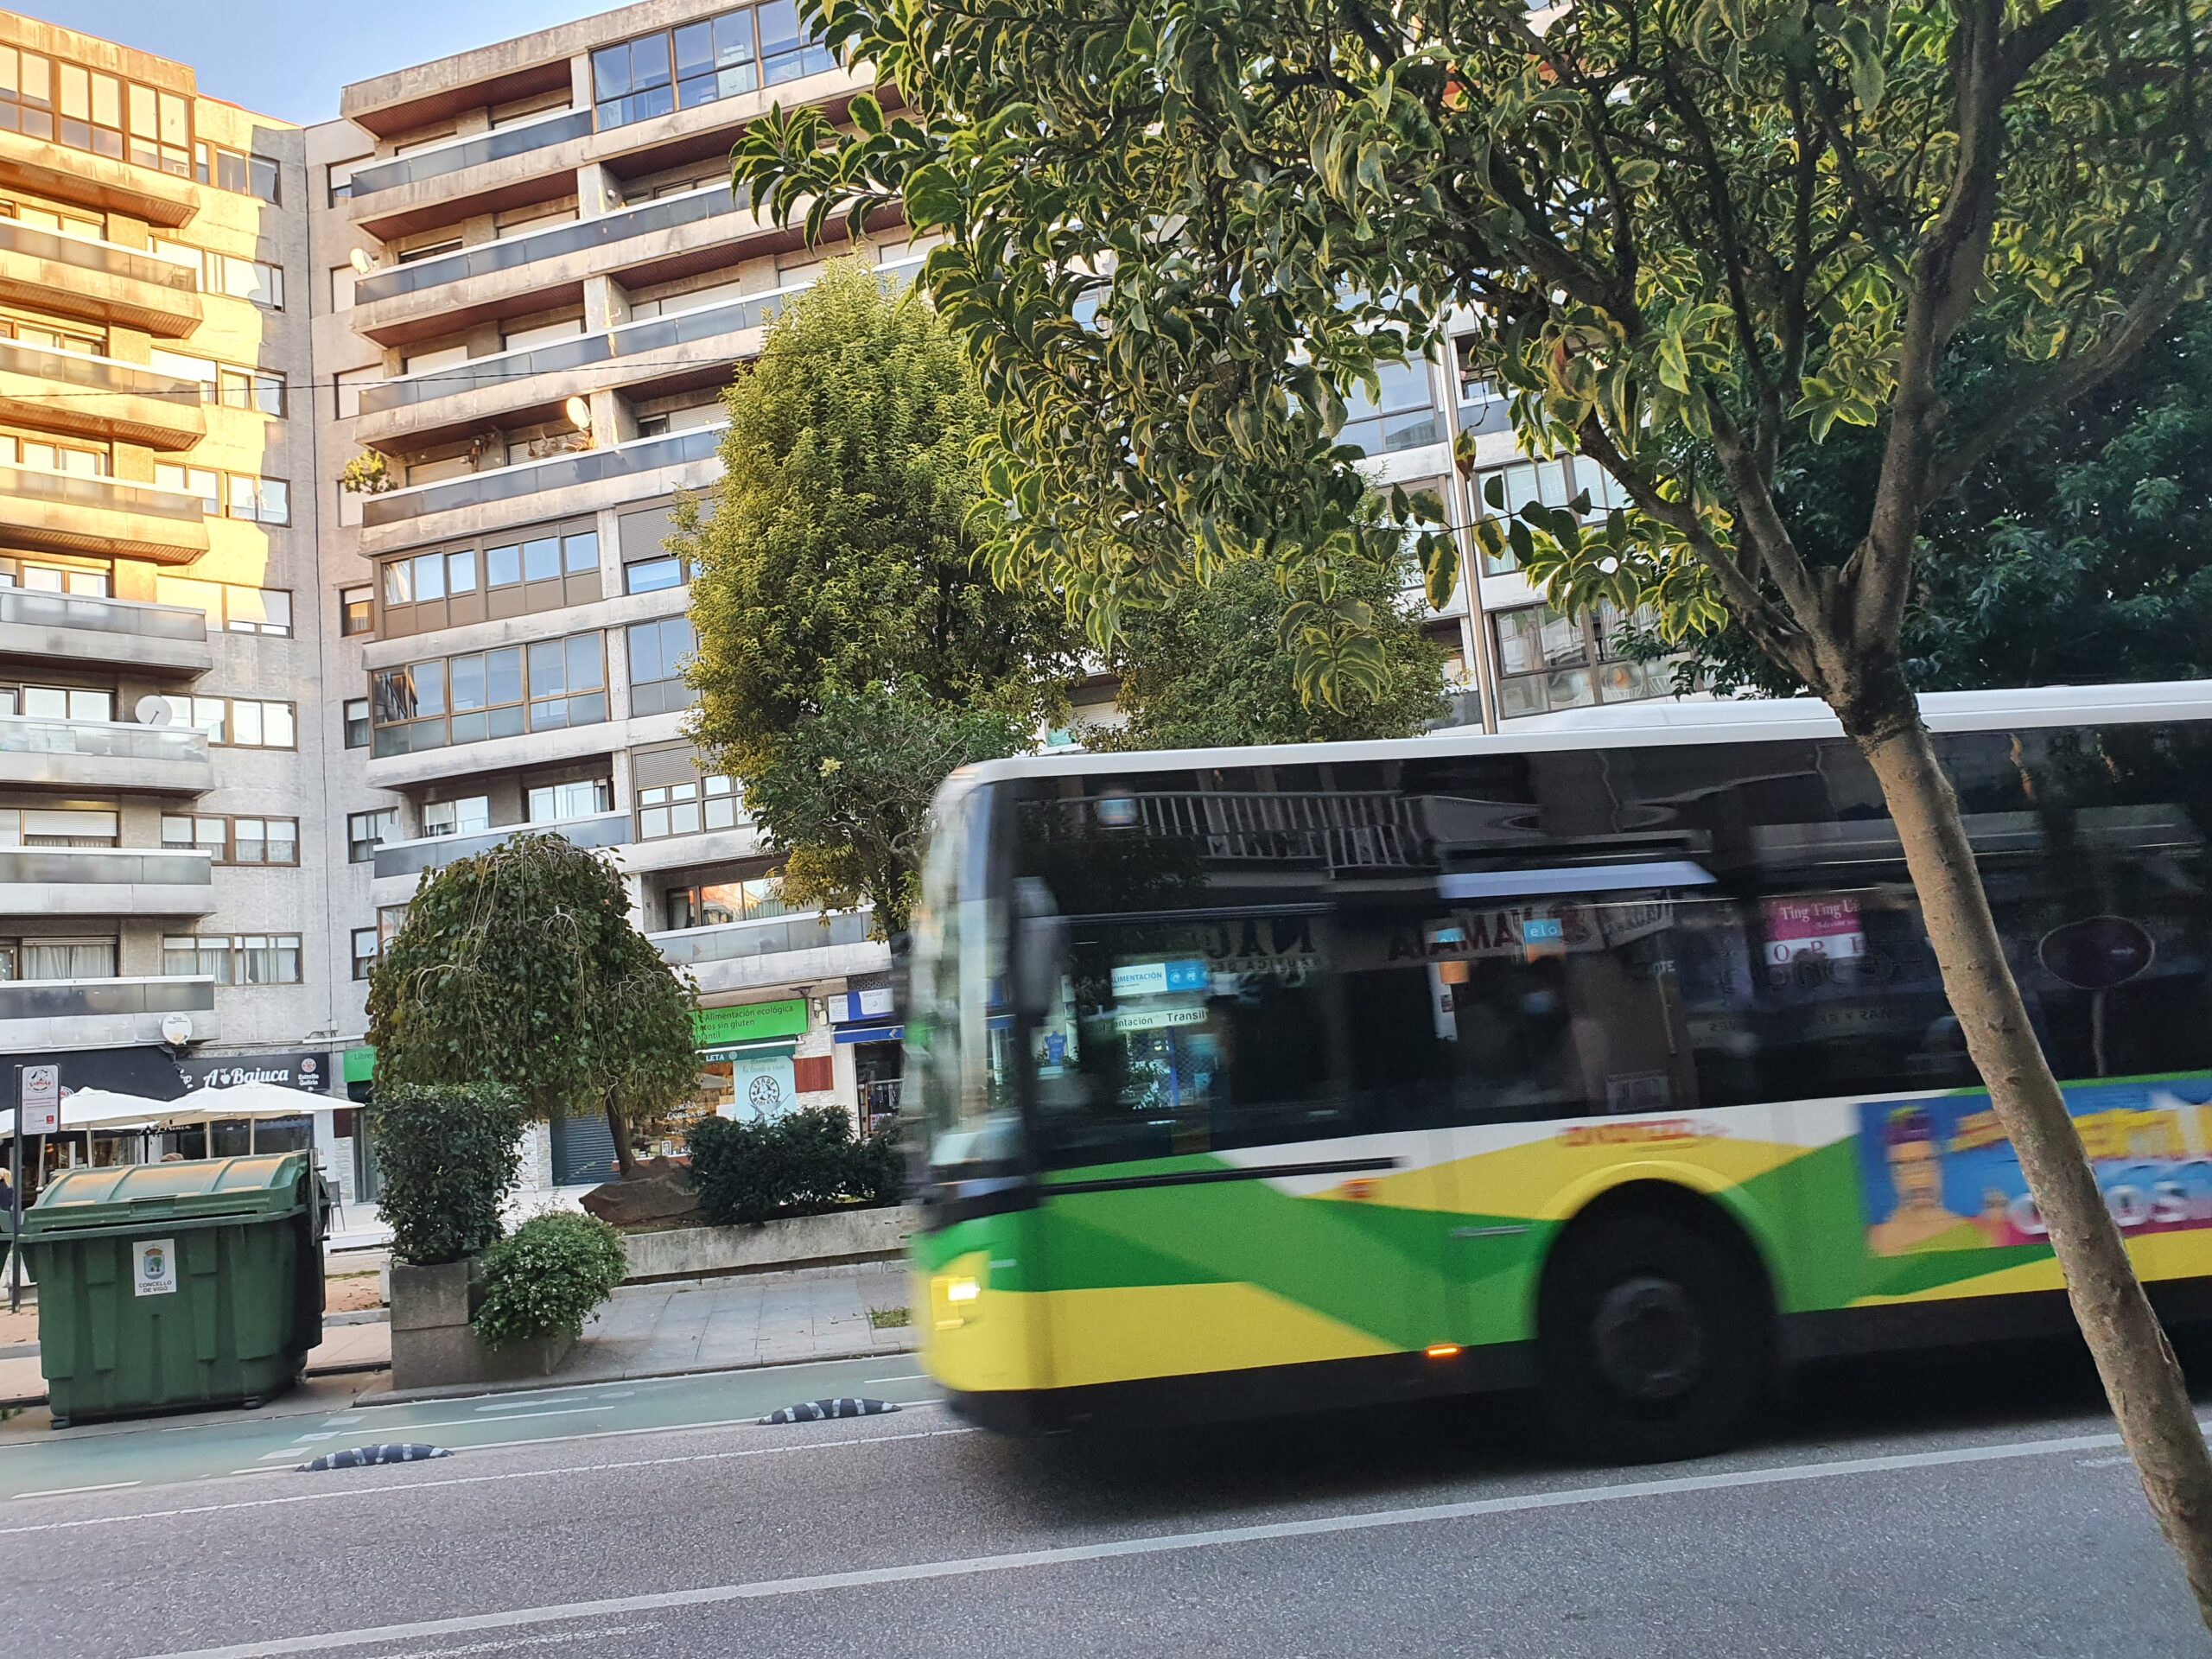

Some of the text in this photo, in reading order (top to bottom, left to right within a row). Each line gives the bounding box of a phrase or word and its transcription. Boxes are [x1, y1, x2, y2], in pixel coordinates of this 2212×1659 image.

[1779, 905, 1810, 923] Ting
[1811, 901, 1842, 919] Ting
[757, 1005, 794, 1016] ecológica
[718, 1020, 728, 1029] sin
[730, 1019, 755, 1030] gluten
[203, 1069, 219, 1088] A
[138, 1280, 172, 1288] CONCELLO
